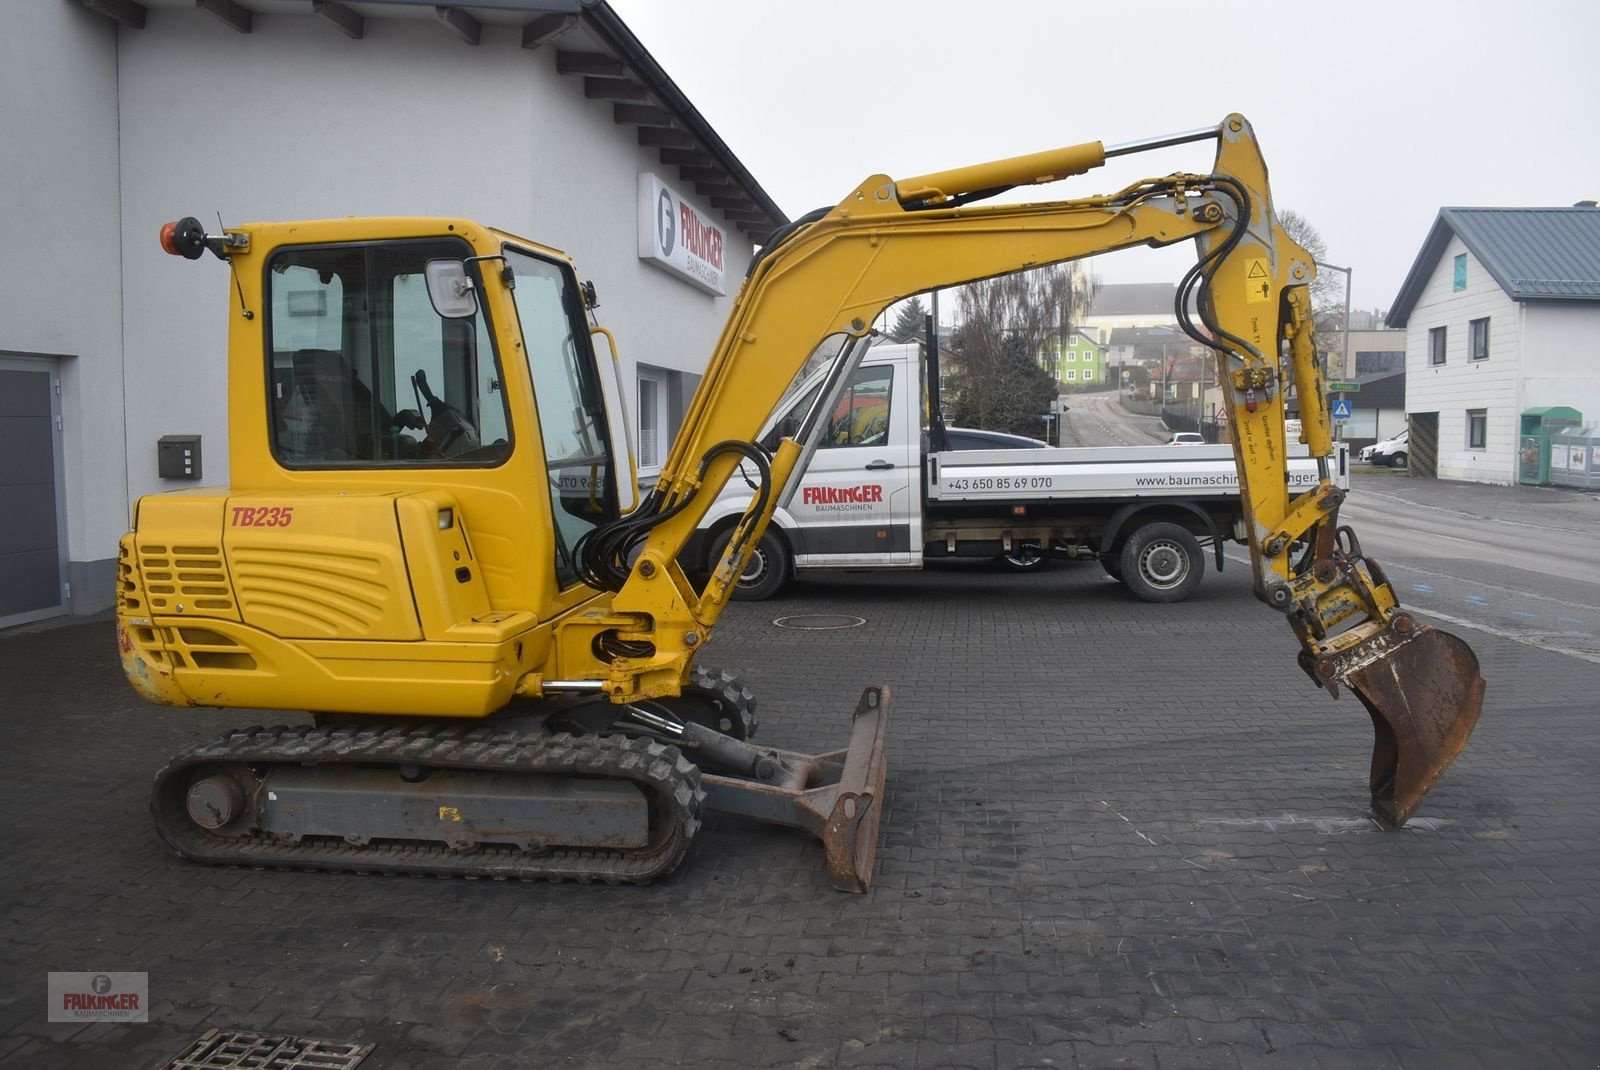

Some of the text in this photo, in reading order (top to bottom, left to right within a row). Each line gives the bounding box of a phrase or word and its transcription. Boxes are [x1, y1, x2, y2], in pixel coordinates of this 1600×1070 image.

[679, 200, 723, 272] FALKINGER
[948, 477, 1052, 489] +43 650 85 69 070
[803, 485, 883, 504] FALKINGER
[231, 507, 294, 527] TB235
[815, 504, 873, 512] BAUMASCHINEN
